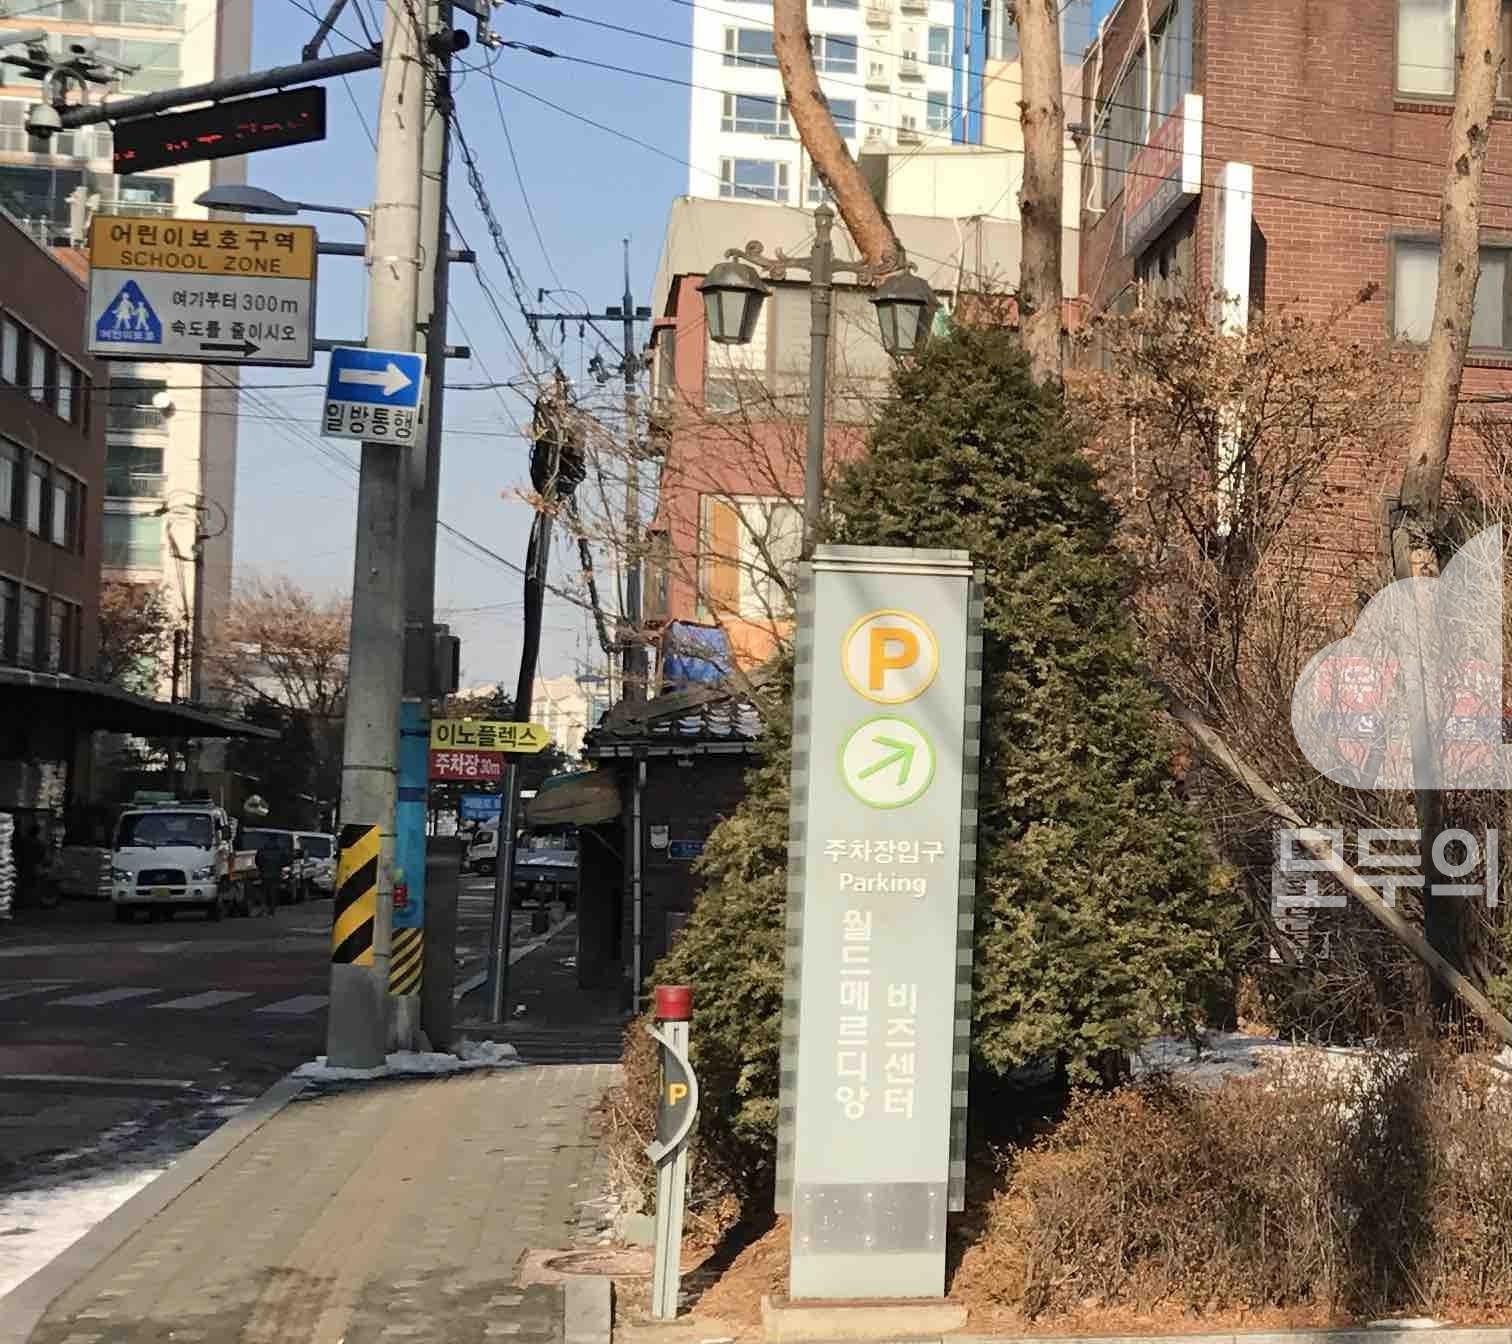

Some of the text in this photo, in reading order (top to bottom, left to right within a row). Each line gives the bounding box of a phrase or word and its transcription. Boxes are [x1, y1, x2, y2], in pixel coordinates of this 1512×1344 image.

[110, 223, 297, 253] 어린이보호구역
[120, 249, 281, 274] SCHOOL ZONE
[172, 290, 299, 314] 여기부터 300m
[170, 320, 297, 342] 속도를 줄이시오
[326, 403, 415, 439] 일방통행
[869, 627, 919, 690] P
[436, 723, 538, 748] 이노플렉스
[435, 752, 479, 776] 주차장
[824, 839, 945, 865] 주차장입구
[840, 871, 928, 898] Parking
[834, 909, 873, 1121] 월드메르디앙
[884, 983, 919, 1120] 비즈센터
[669, 1083, 688, 1106] P
